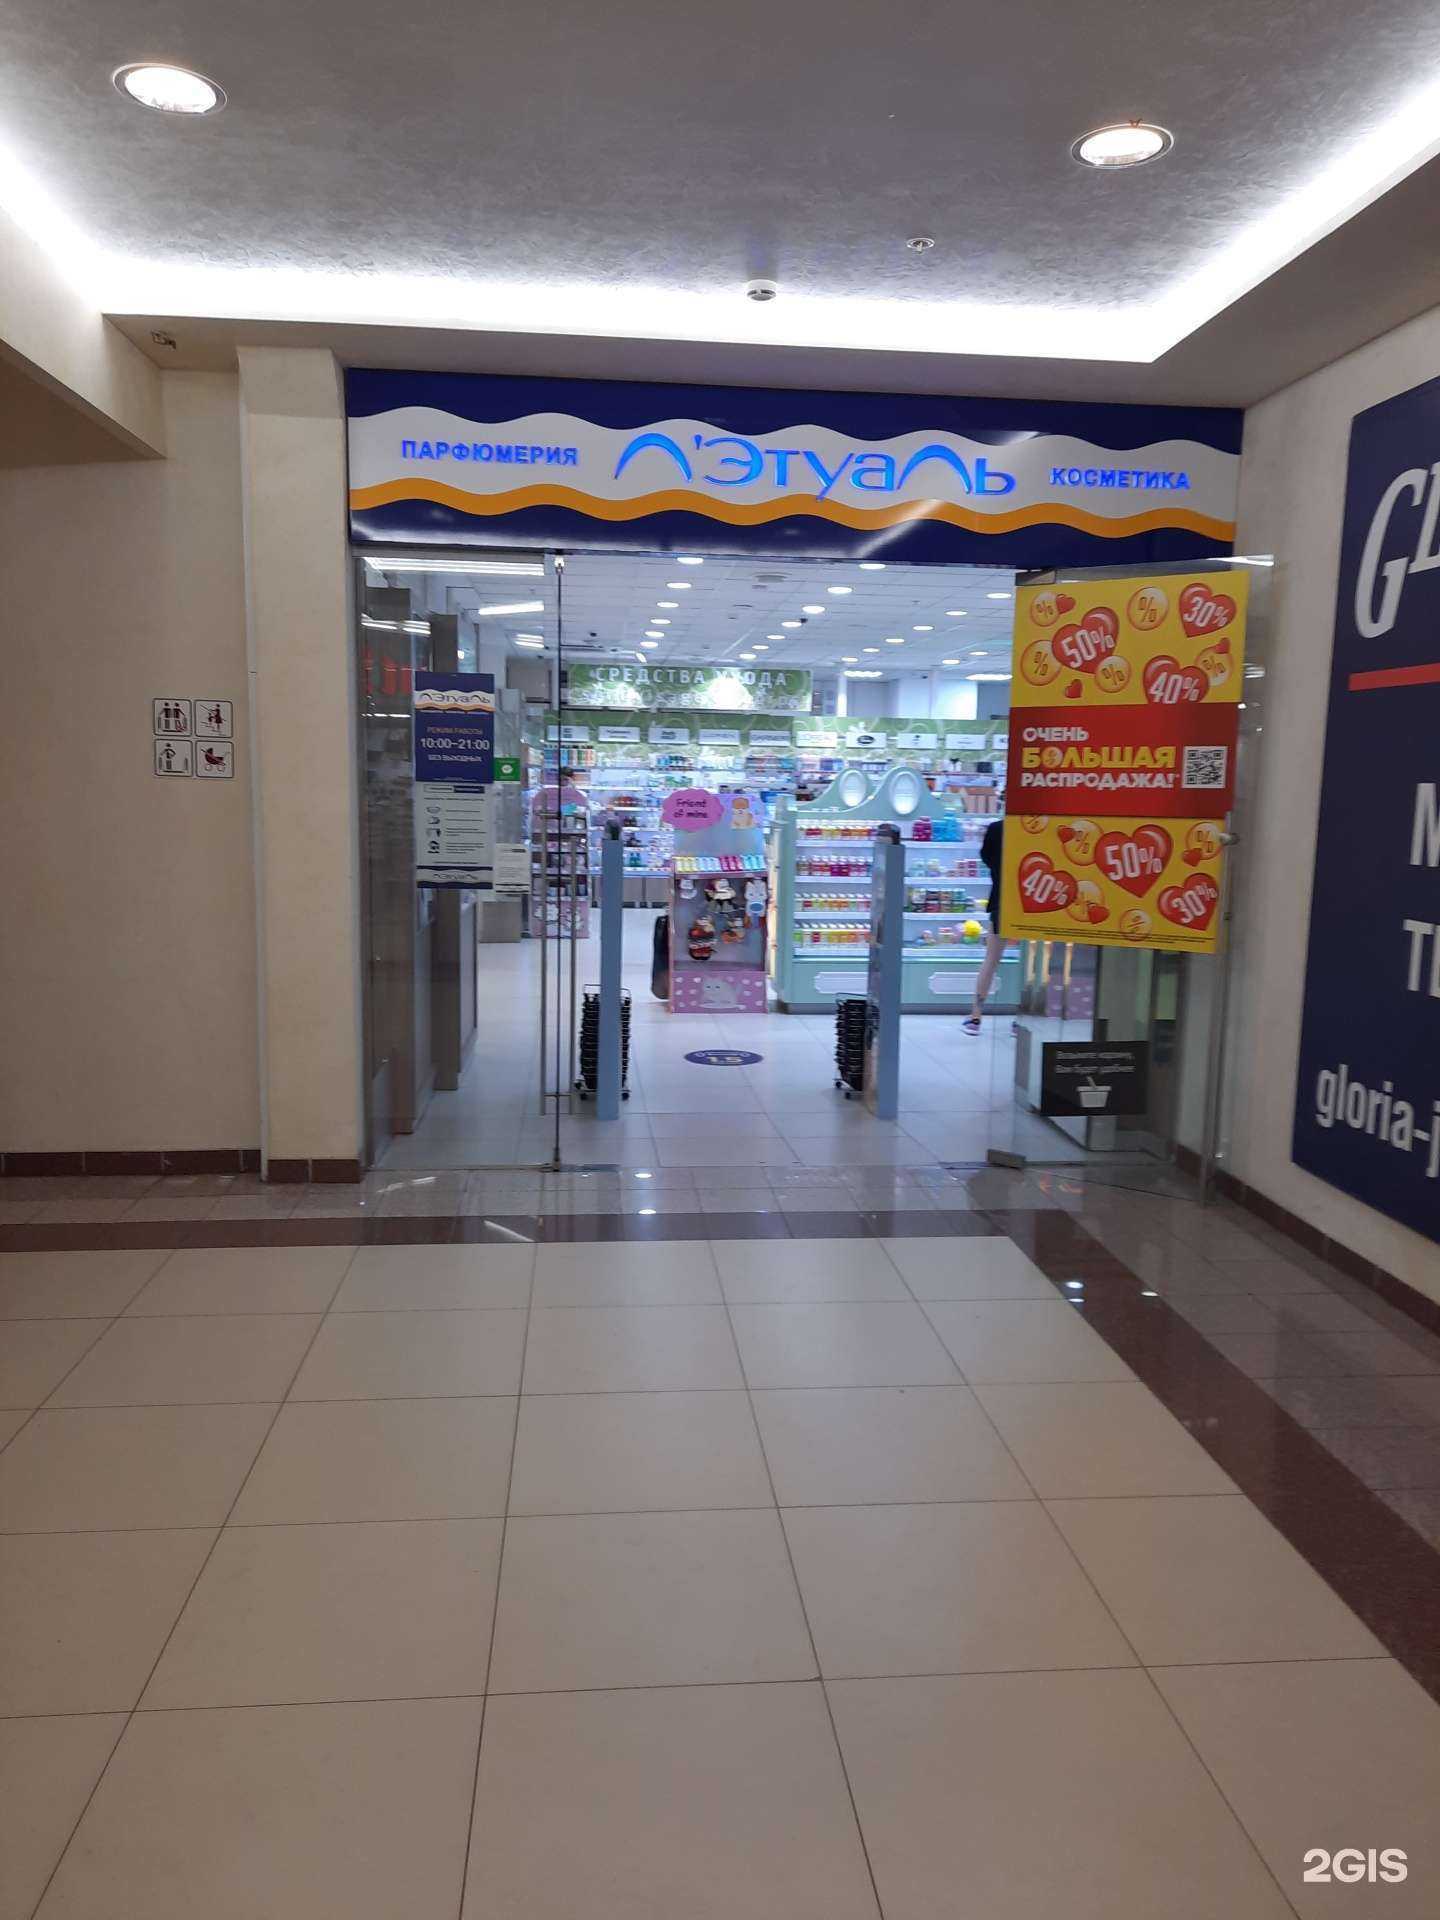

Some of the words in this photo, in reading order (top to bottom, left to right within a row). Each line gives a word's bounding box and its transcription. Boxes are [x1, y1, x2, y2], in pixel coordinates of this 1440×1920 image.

[401, 439, 579, 466] ПАРФЮМЕРИЯ
[1050, 467, 1190, 490] КОСМЕТИКА
[1183, 596, 1229, 628] 30%
[1060, 626, 1115, 668] 50%
[595, 667, 705, 686] СРЕДСТВА
[1149, 671, 1201, 705] 40%
[1022, 726, 1089, 742] ОЧЕНЬ
[1021, 745, 1177, 769] БОЛЬШАЯ
[1103, 842, 1163, 881] 50%
[1022, 868, 1069, 906] 40%
[1171, 882, 1218, 924] 30%
